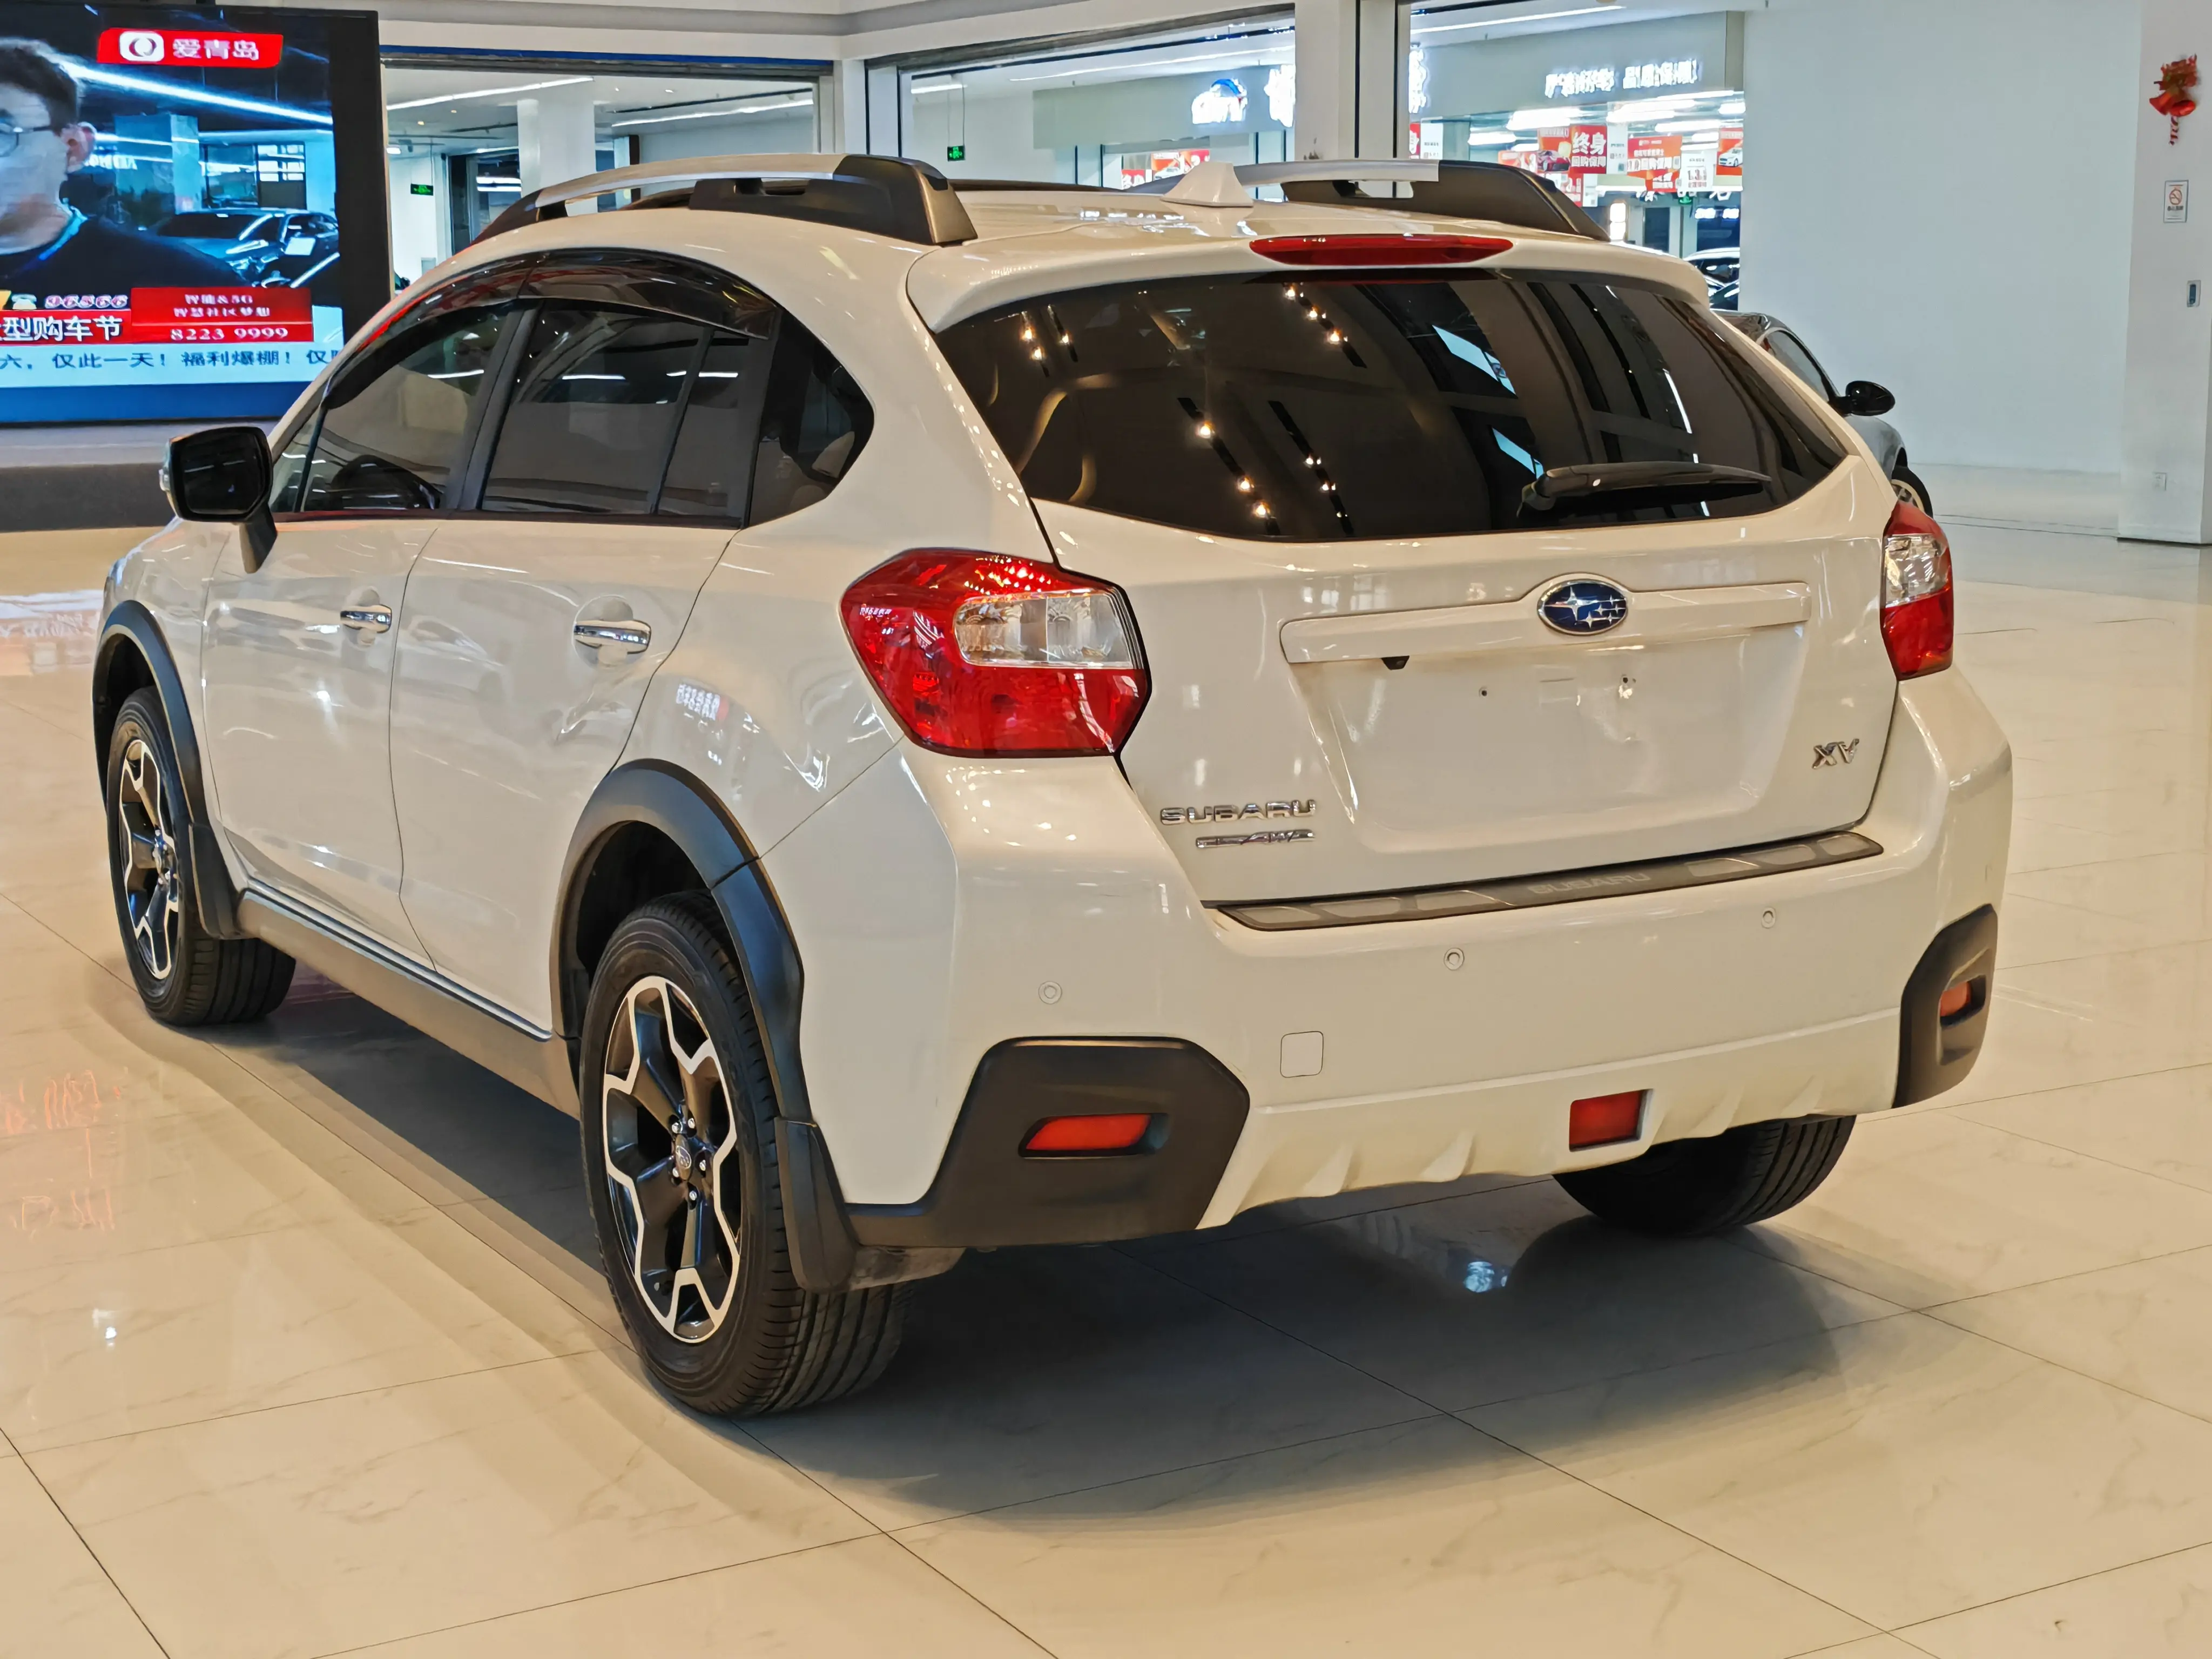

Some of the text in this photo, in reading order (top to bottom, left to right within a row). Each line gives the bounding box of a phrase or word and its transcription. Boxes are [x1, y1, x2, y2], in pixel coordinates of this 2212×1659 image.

[172, 38, 259, 60] 爱青岛
[1572, 132, 1607, 155] 终身
[0, 315, 123, 342] 型购车节
[234, 327, 288, 339] 9999
[1811, 738, 1860, 770] XV
[1160, 799, 1316, 825] SUBARU
